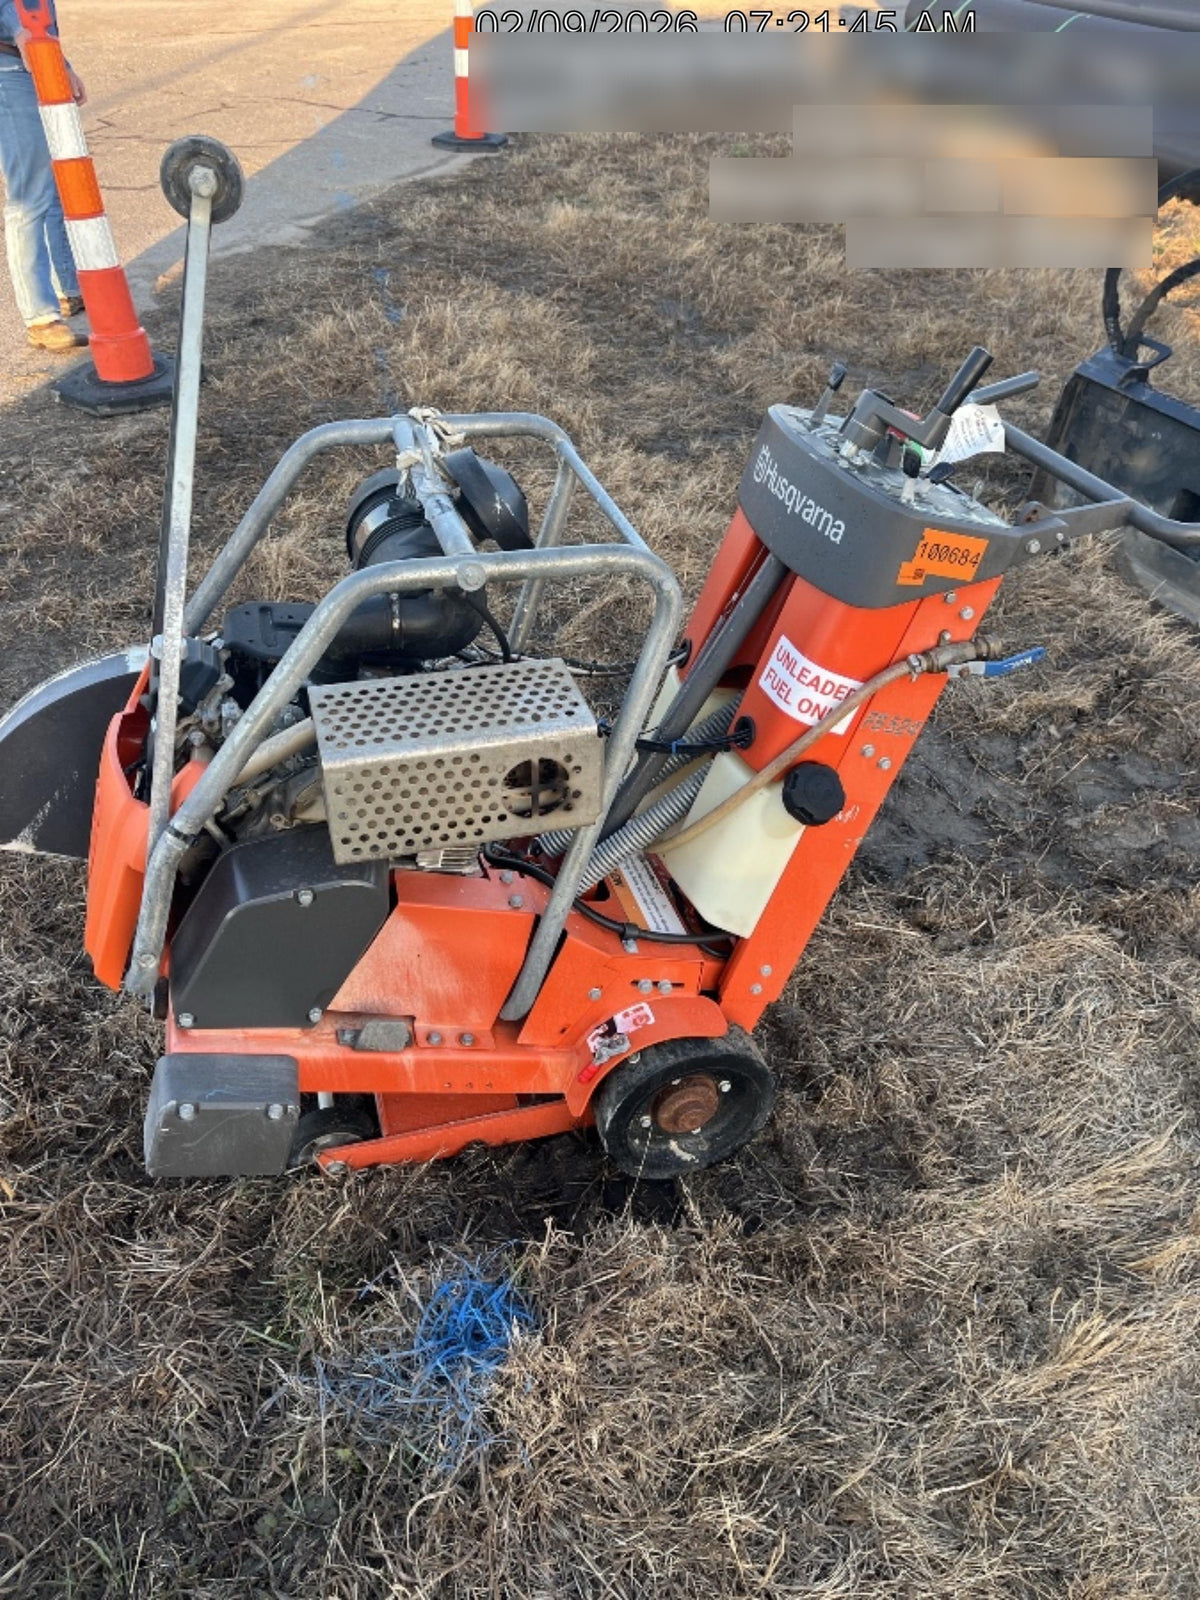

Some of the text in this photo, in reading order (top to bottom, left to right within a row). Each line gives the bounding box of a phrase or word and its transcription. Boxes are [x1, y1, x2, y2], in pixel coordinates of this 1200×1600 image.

[762, 457, 846, 545] Husqvarna
[919, 541, 982, 568] 100684
[763, 666, 793, 706] FUEL
